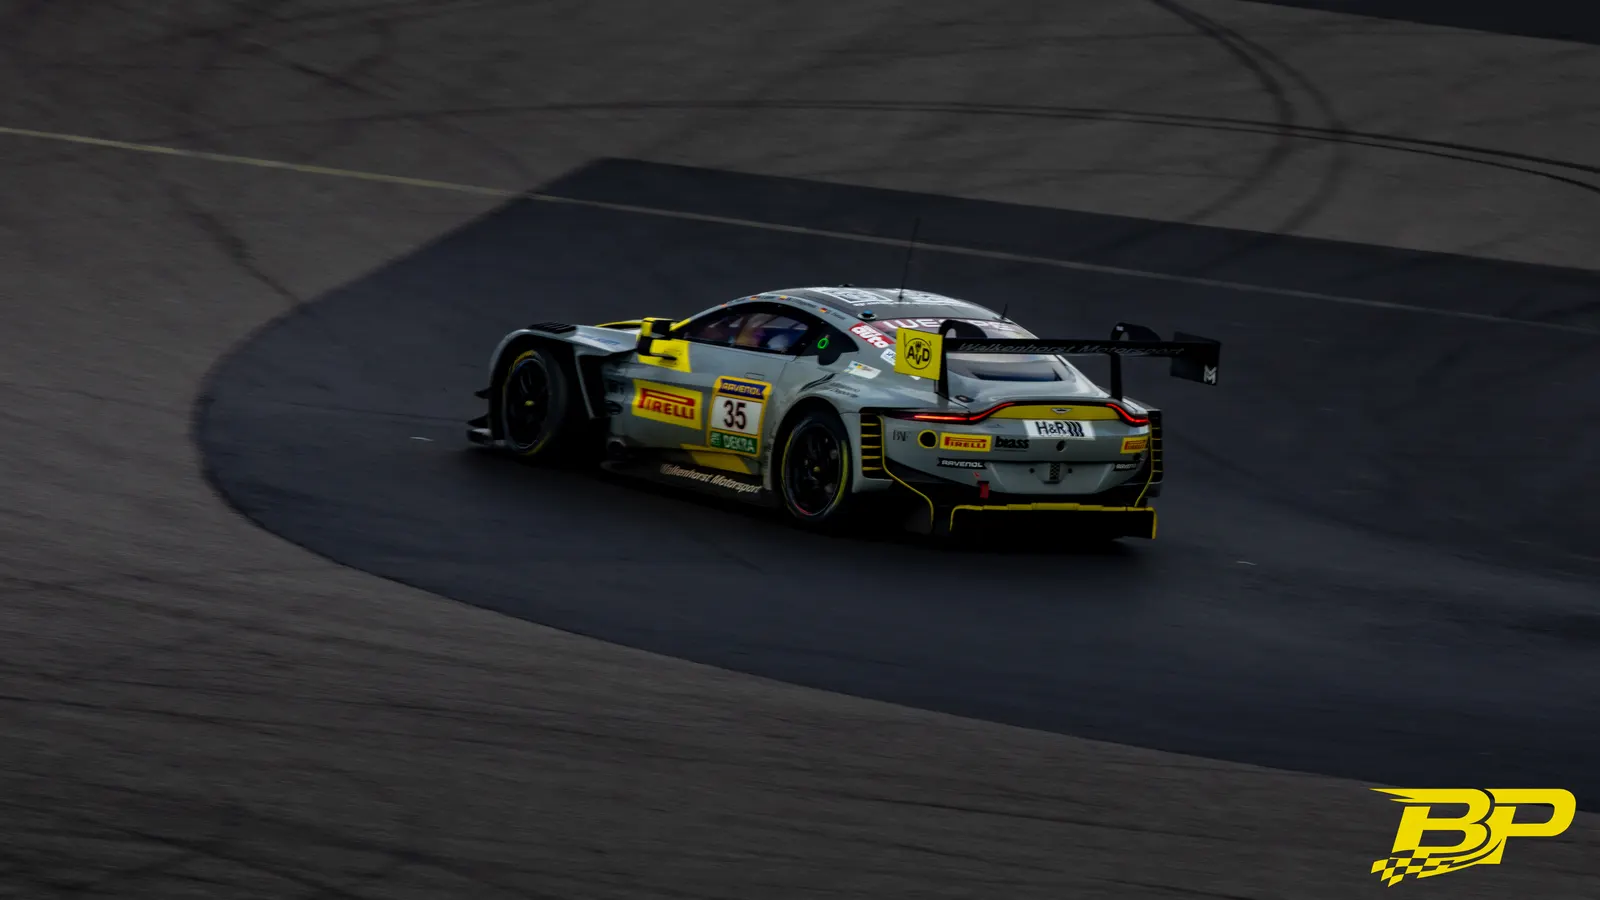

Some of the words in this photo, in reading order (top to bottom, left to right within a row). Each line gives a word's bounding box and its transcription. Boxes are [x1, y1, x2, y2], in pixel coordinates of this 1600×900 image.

[638, 387, 696, 420] PIRELLI
[723, 400, 747, 430] 35
[1035, 420, 1067, 435] H&R
[723, 434, 756, 454] DEKRA
[944, 435, 987, 448] PIRELLI
[941, 459, 983, 468] RAVENOL
